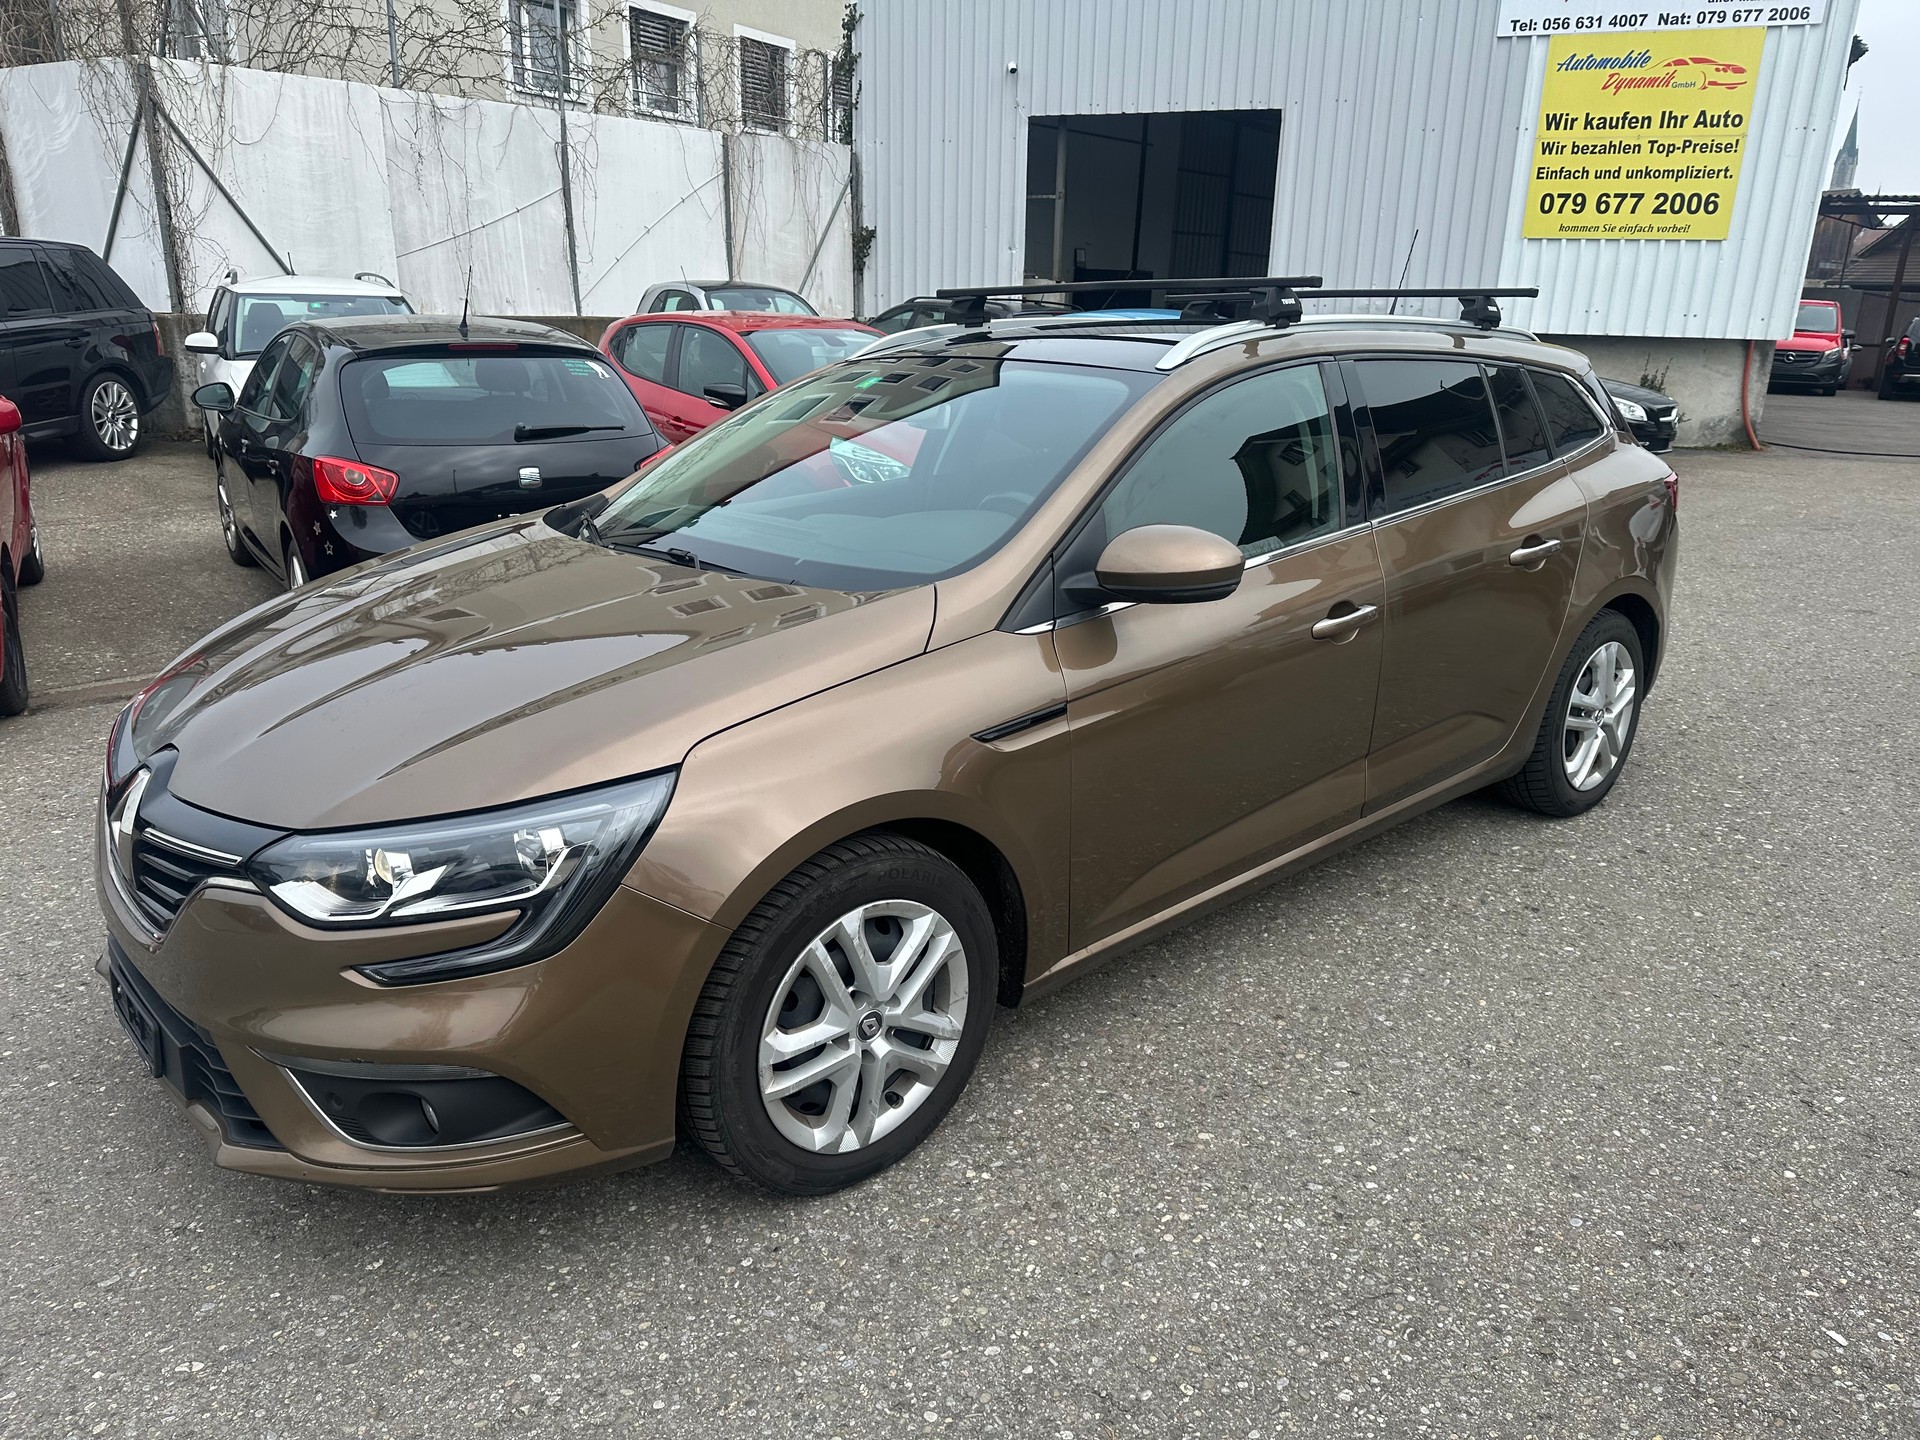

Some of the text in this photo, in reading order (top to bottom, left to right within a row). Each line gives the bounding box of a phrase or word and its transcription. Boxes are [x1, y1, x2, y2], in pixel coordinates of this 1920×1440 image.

[1510, 7, 1811, 32] Tel: 056 631 4007 Nat: 079 677 2006
[1556, 49, 1653, 73] Automobile
[1601, 69, 1697, 96] Dynamik GmbH
[1545, 109, 1744, 132] Wir kaufen Ihr Auto
[1540, 138, 1740, 158] Wir bezahlen Top-Preise!
[1535, 165, 1734, 183] Einfach und unkompliziert.
[1539, 192, 1720, 215] 079 677 2006
[1558, 223, 1691, 235] kommen Sie einfach vorbei!
[877, 866, 945, 888] POLARIS
